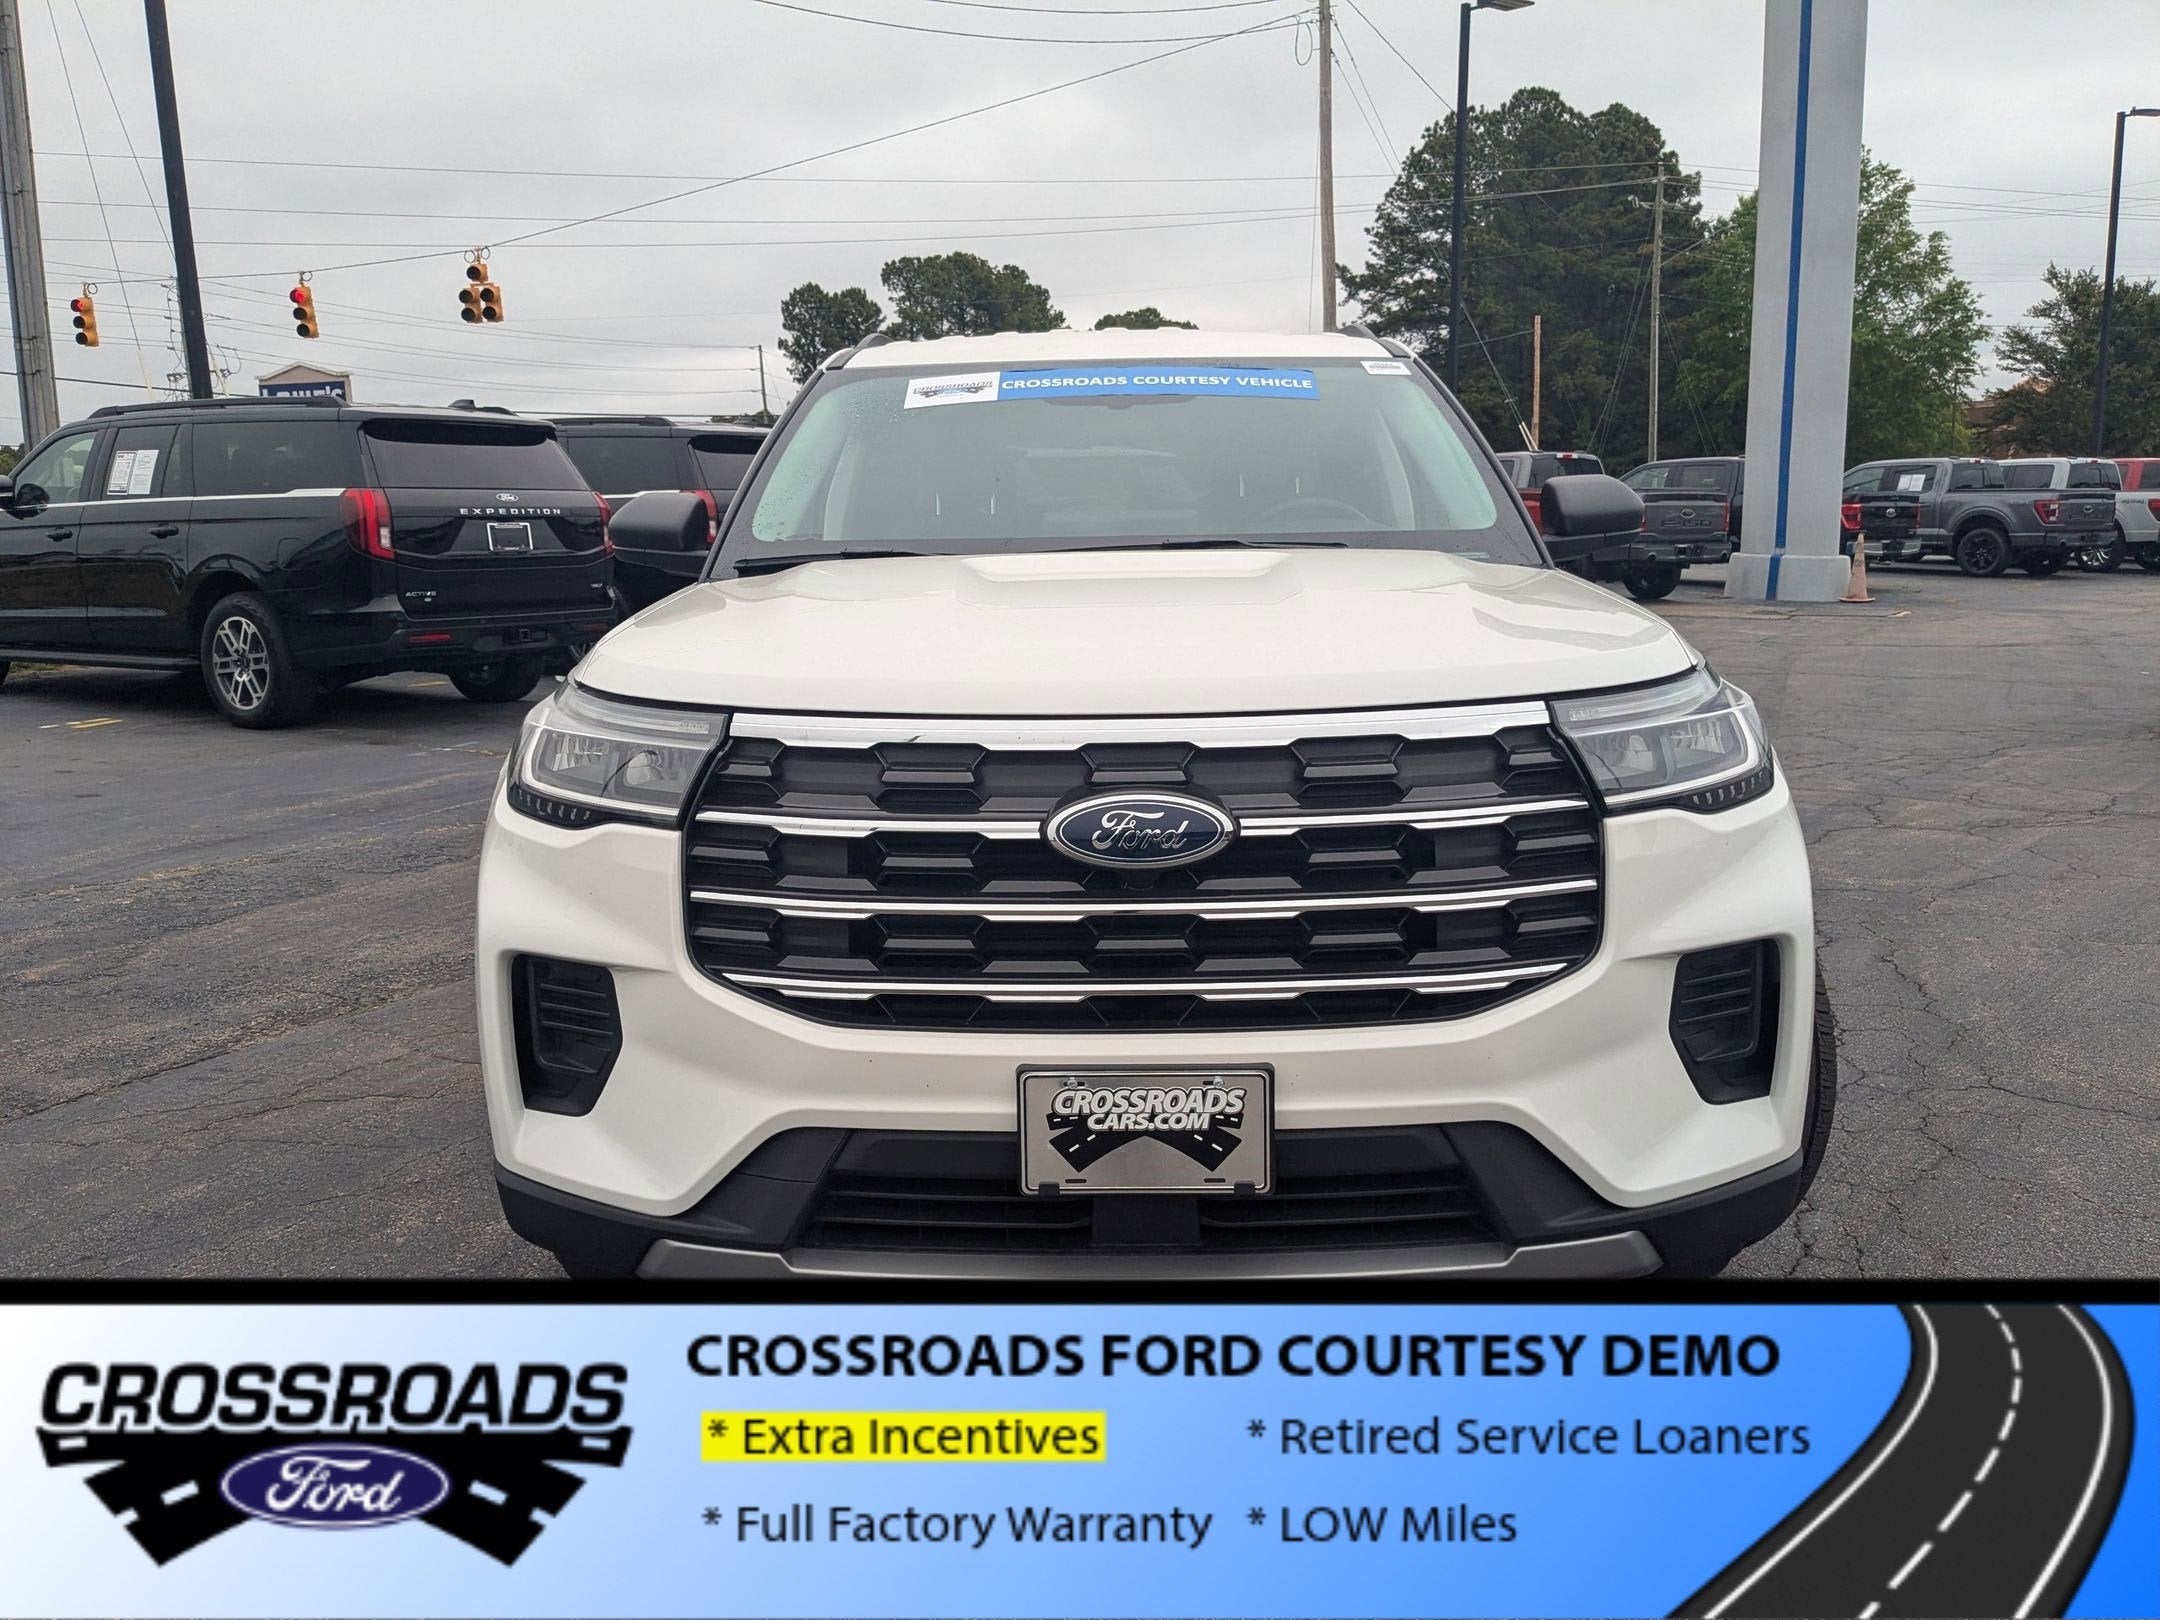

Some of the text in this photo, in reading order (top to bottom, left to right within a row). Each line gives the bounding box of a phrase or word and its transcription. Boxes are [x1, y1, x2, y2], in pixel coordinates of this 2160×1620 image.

[1002, 376, 1313, 389] CROSSROADS COURTESY VEHICLE
[1092, 810, 1189, 850] Ford
[1052, 1088, 1246, 1115] CROSSROADS
[1087, 1113, 1210, 1131] CARS.COM
